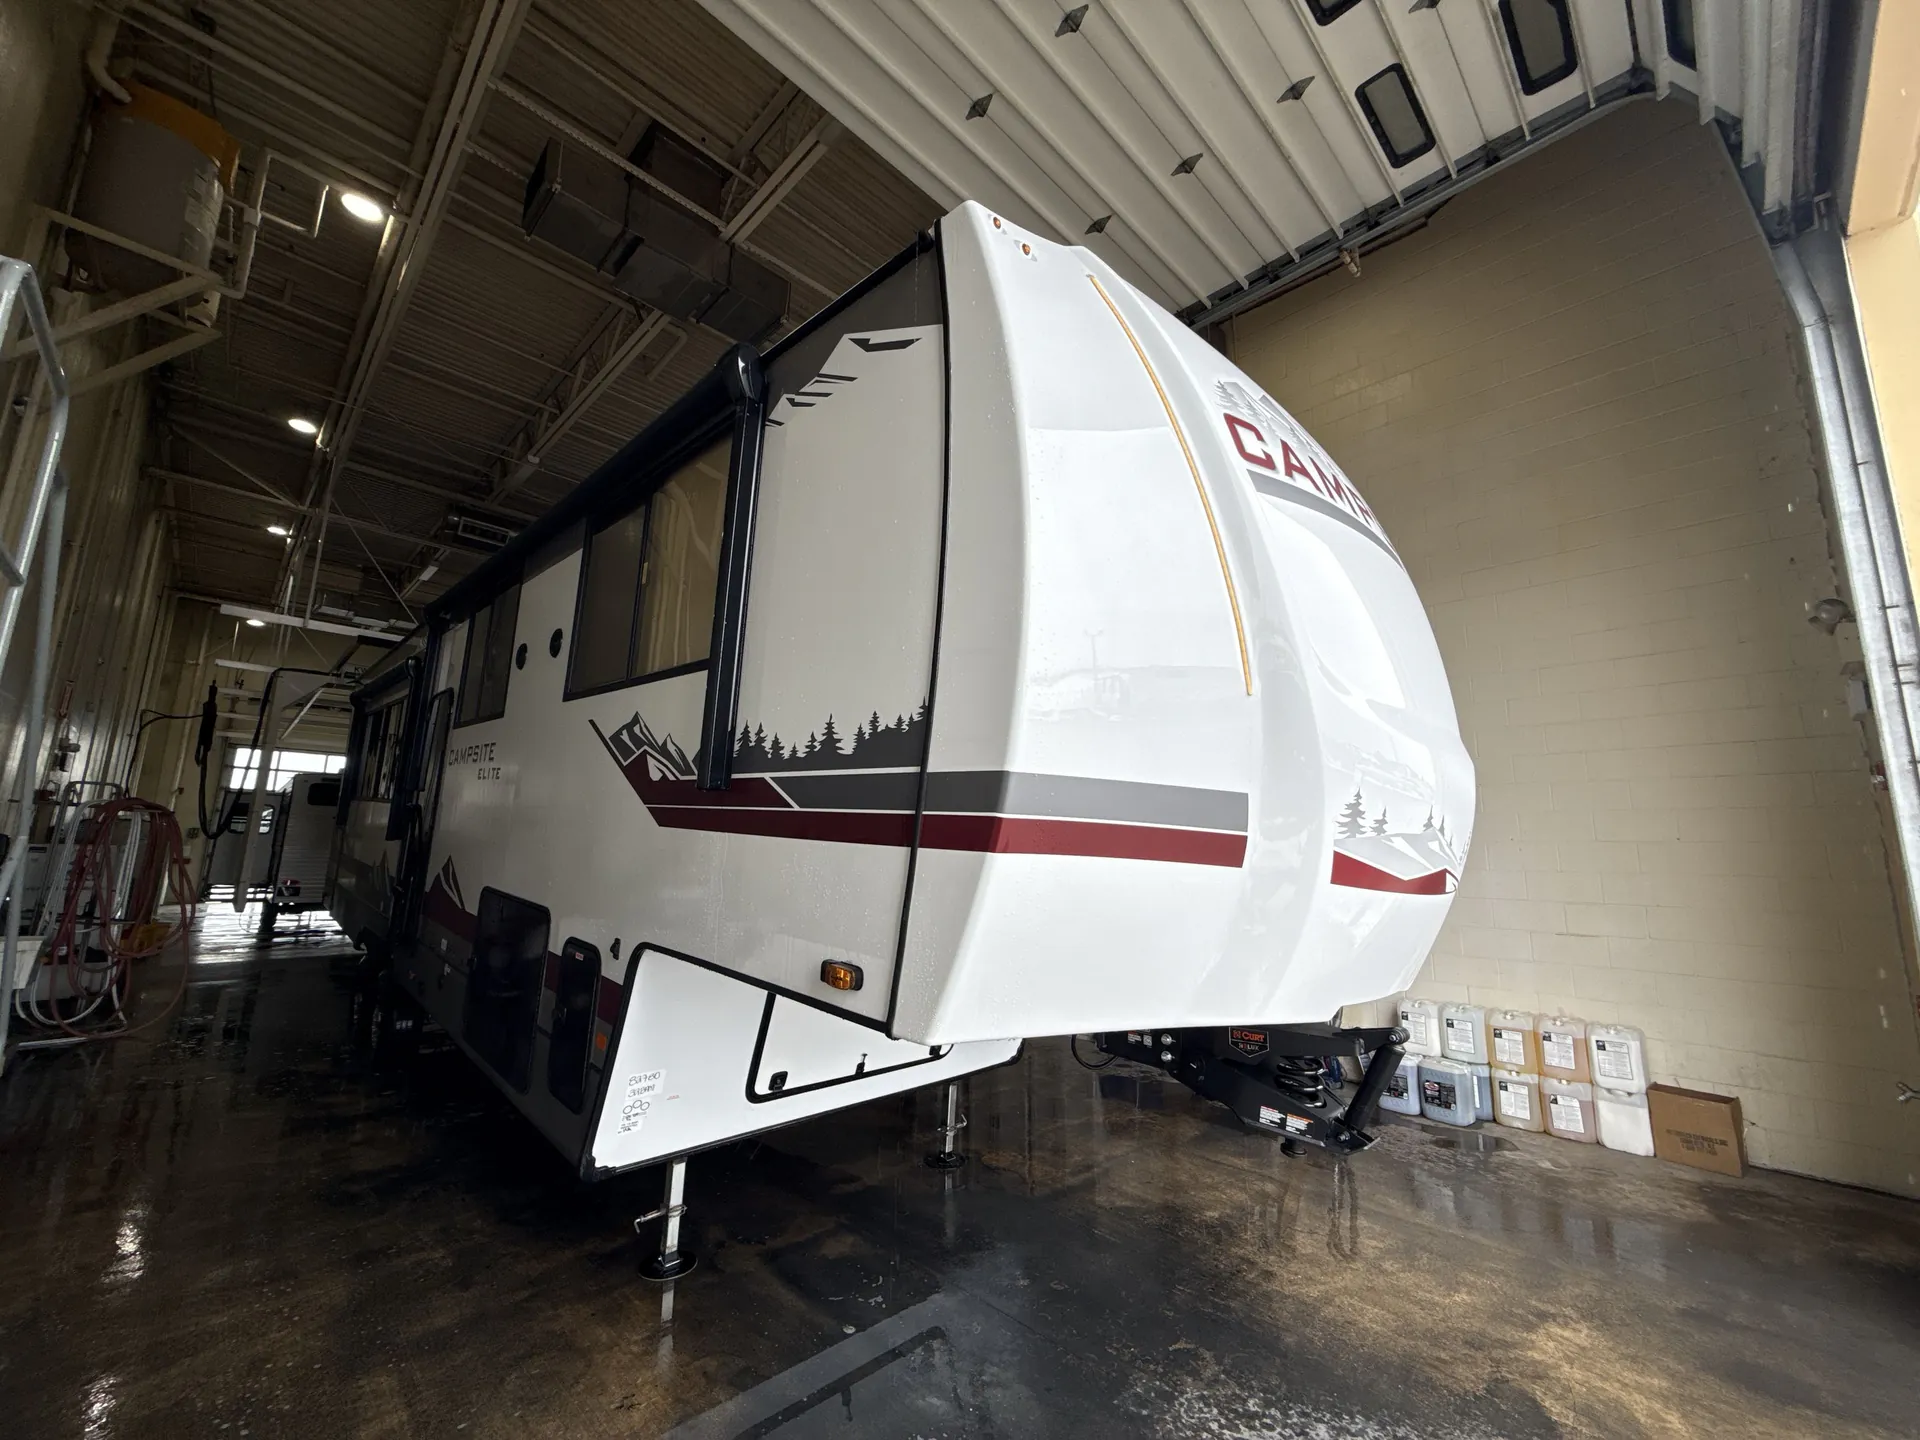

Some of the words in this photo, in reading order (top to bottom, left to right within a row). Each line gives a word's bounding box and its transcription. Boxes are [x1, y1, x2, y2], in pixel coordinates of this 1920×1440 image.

[448, 742, 497, 766] CAMPSITE
[477, 767, 501, 780] ELITE
[1242, 1031, 1265, 1042] CURT
